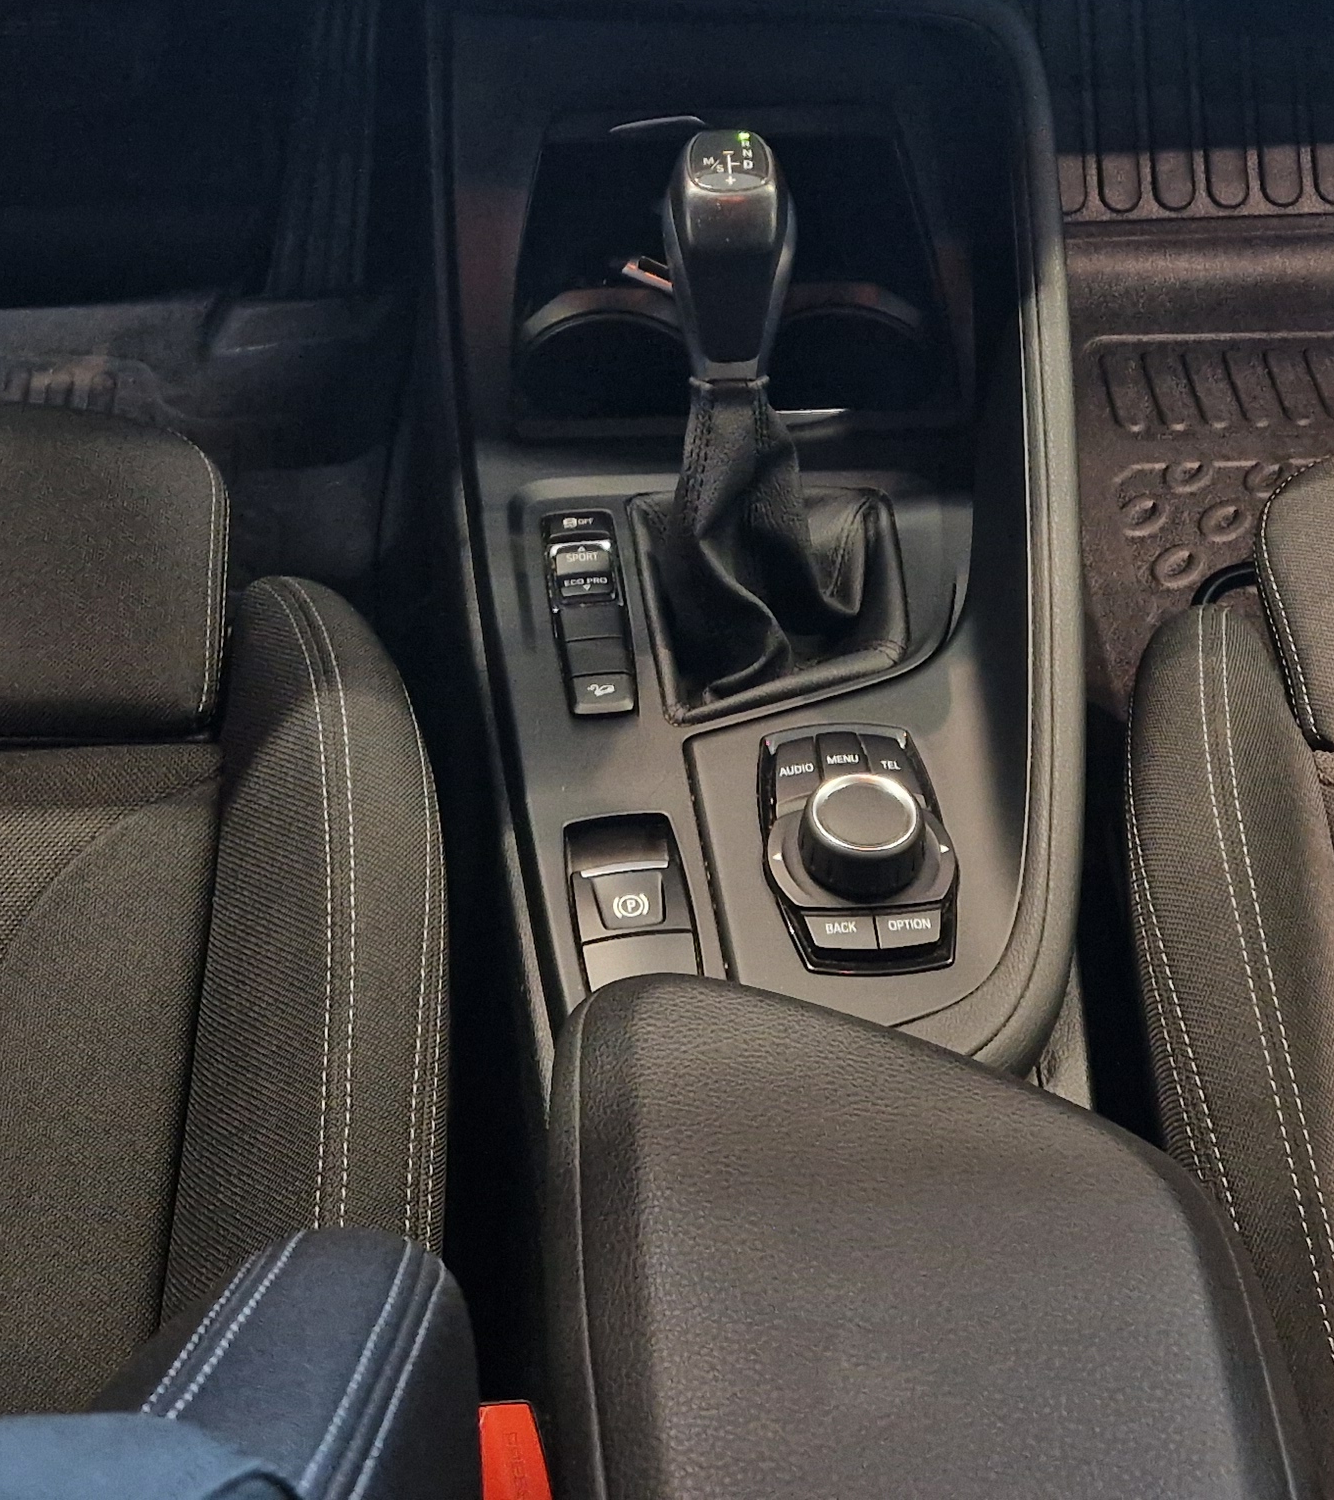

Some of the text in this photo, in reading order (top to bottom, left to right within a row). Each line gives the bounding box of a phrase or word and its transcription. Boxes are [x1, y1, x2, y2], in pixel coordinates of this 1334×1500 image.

[742, 148, 753, 158] N
[743, 159, 754, 170] D
[566, 551, 598, 562] SPORT
[564, 576, 608, 587] ECO PRO
[827, 753, 859, 765] MENU
[779, 762, 814, 777] AUDIO
[880, 760, 901, 771] TEL
[825, 922, 857, 934] BACK
[888, 918, 932, 932] OPTION
